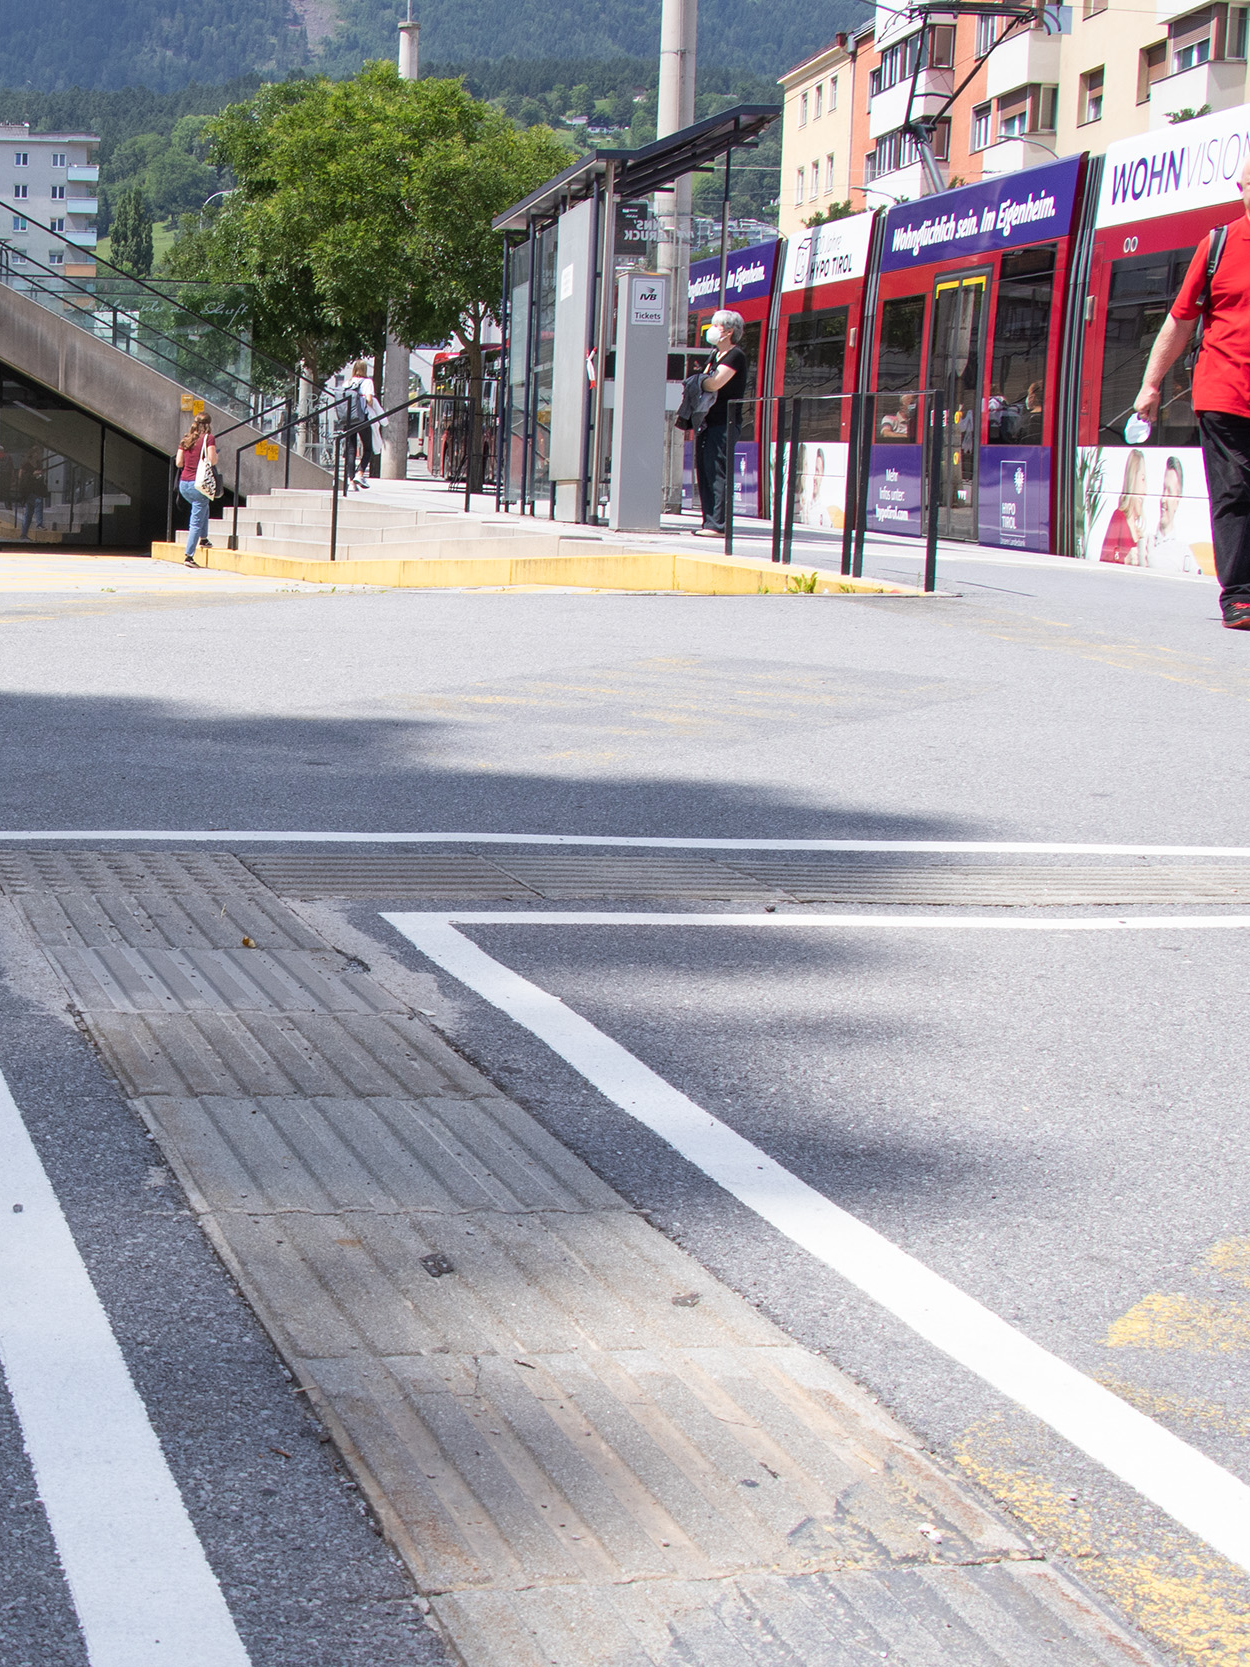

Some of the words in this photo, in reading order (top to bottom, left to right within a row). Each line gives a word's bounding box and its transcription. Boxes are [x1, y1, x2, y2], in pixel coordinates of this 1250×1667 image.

[891, 213, 956, 257] Wohnglücklich
[955, 208, 979, 240] sein.
[980, 206, 997, 233] Im
[996, 189, 1056, 237] Eigenheim.
[808, 258, 831, 281] HYPO
[832, 253, 853, 276] TIROL
[639, 293, 658, 301] IVB
[634, 311, 661, 320] Tickets
[885, 467, 899, 482] Mehr
[879, 485, 891, 501] Infos
[891, 488, 906, 502] unter:
[875, 503, 909, 523] hypotirol.com
[1001, 502, 1016, 516] HYPO
[1001, 515, 1017, 530] TIROL
